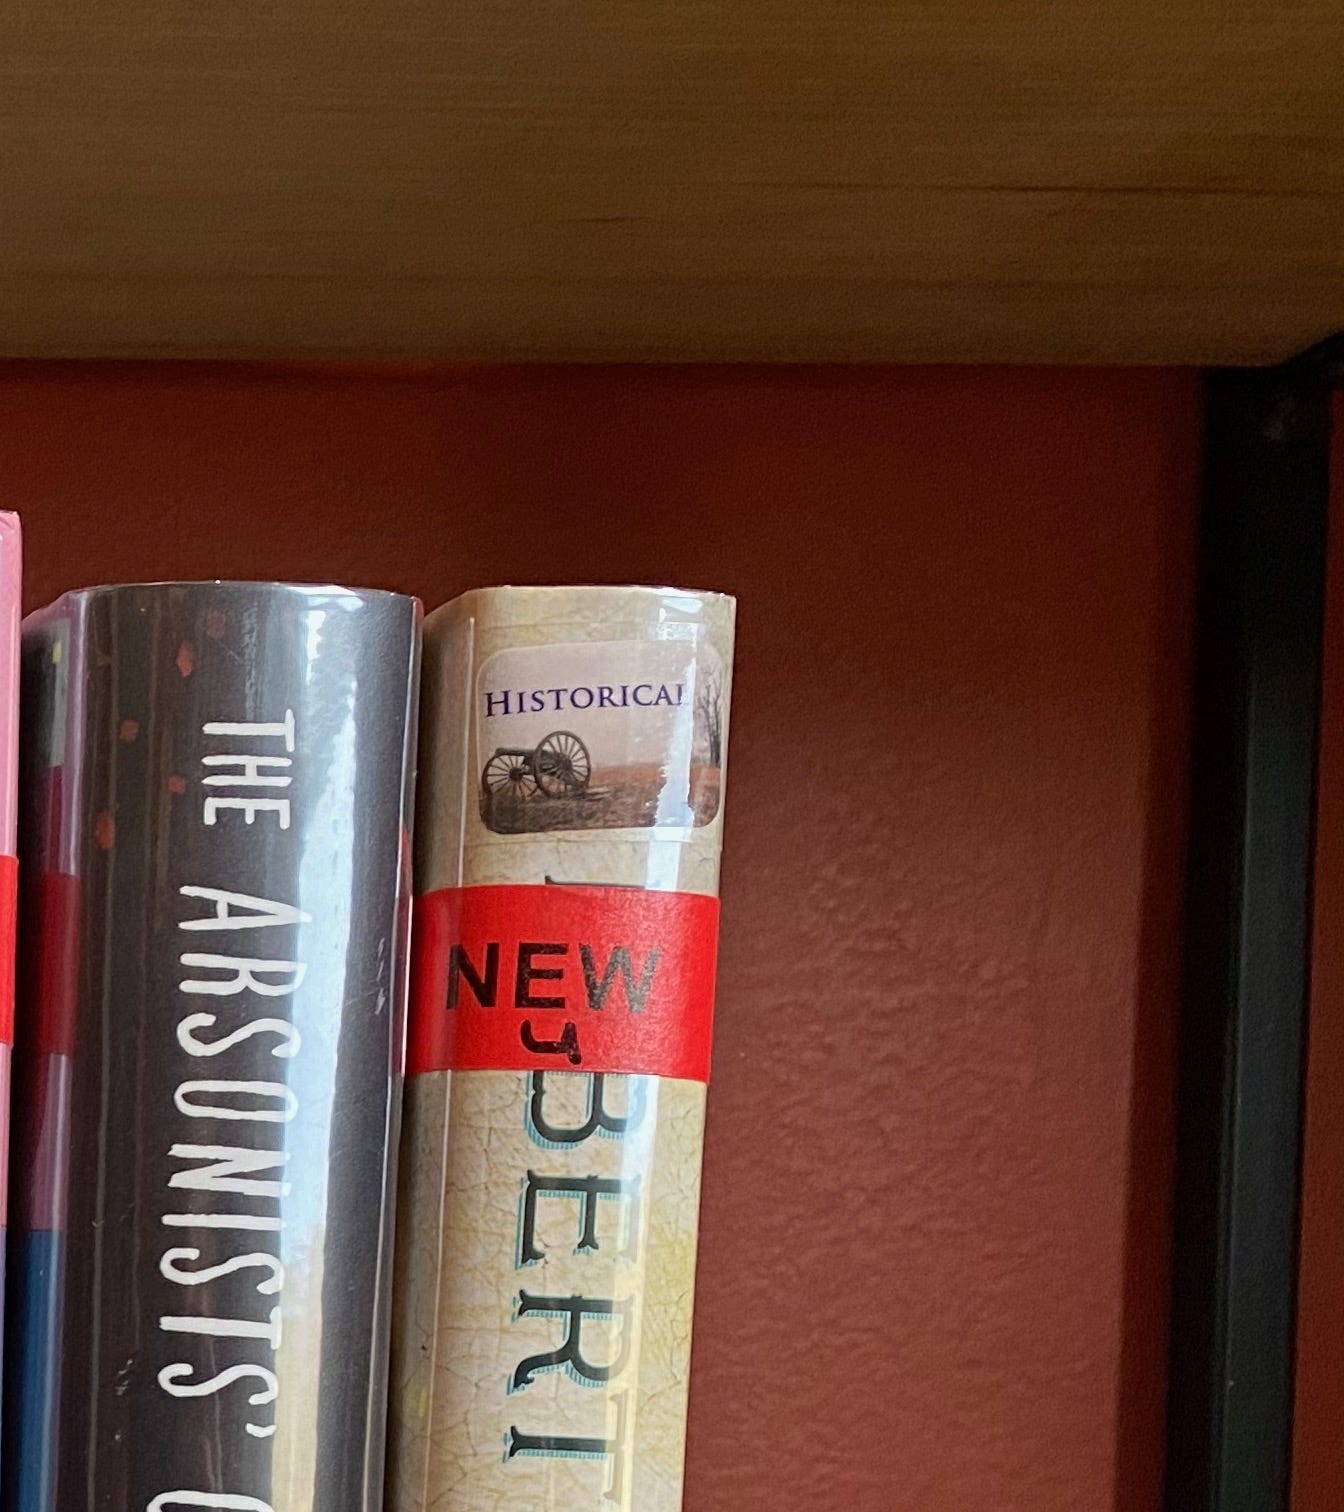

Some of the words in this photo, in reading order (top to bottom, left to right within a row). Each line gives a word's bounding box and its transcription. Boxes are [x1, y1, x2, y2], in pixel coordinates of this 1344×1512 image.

[484, 683, 690, 718] HISTORICAL
[201, 708, 296, 830] THE
[446, 941, 660, 1014] NEW
